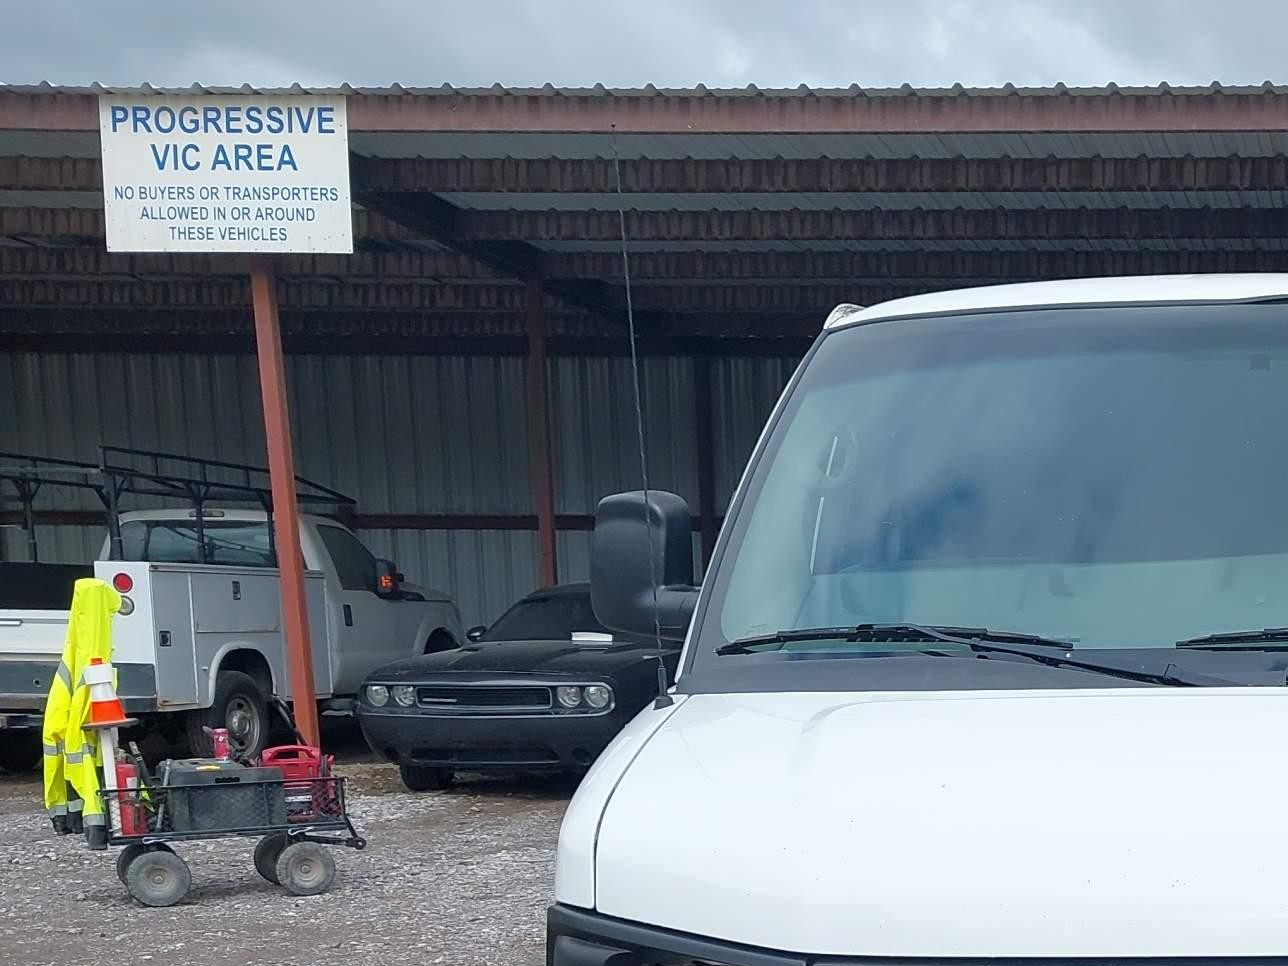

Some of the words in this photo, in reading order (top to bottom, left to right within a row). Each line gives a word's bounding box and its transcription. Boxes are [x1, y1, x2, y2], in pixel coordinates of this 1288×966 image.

[111, 105, 335, 133] PROGRESSIVE
[150, 143, 201, 171] VIC
[210, 144, 298, 171] AREA
[114, 186, 135, 200] NO
[138, 186, 195, 201] BUYERS
[199, 187, 220, 201] OR
[223, 186, 339, 202] TRANSPORTERS
[139, 206, 209, 221] ALLOWED
[213, 207, 226, 221] IN
[230, 207, 251, 221] OR
[254, 207, 316, 222] AROUND
[168, 226, 214, 241] THESE
[218, 226, 288, 241] VEHICLES
